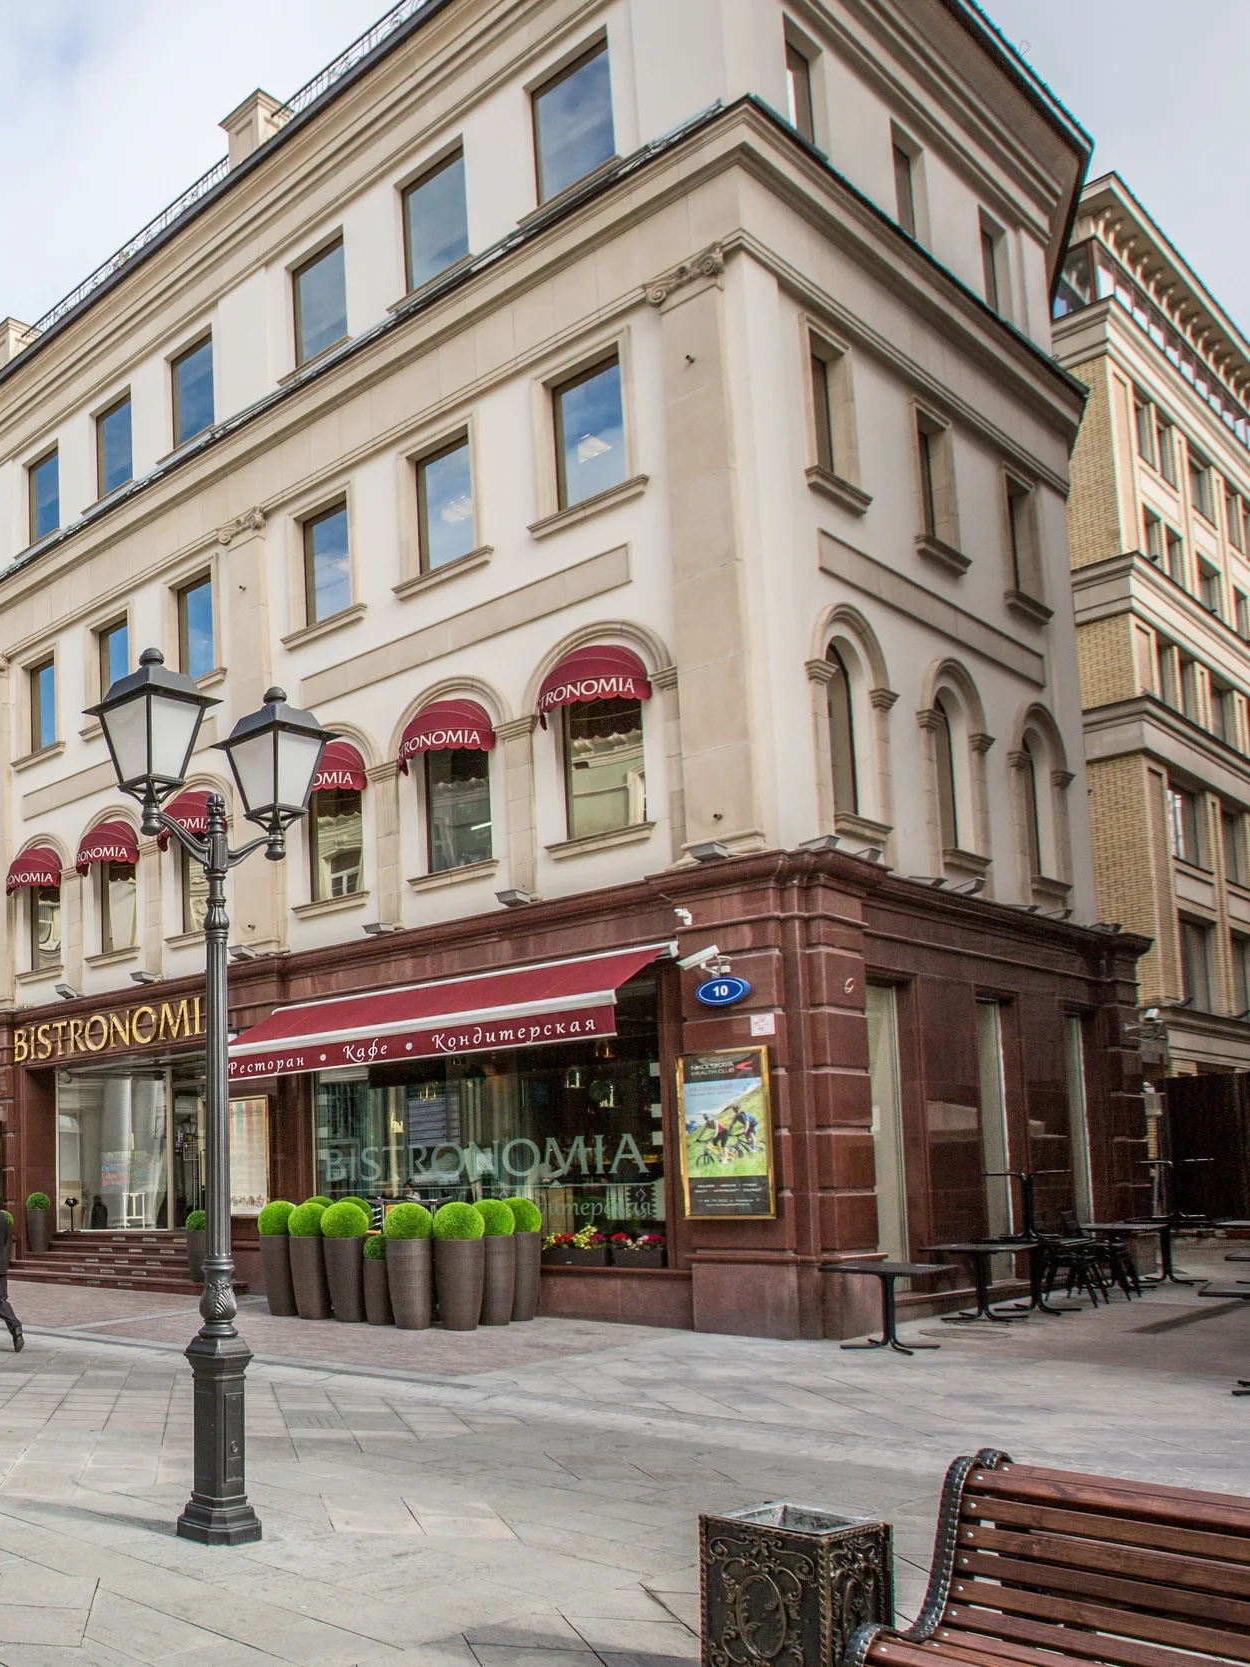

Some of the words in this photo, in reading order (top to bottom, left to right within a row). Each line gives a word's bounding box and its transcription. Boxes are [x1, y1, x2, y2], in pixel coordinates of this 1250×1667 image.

[713, 985, 729, 997] 10
[13, 996, 207, 1062] BISTRONOMI
[228, 1054, 305, 1076] Ресторан
[343, 1038, 388, 1063] Кафе
[432, 1017, 596, 1052] Кондитерская
[325, 1133, 650, 1183] BISTRONOMIA
